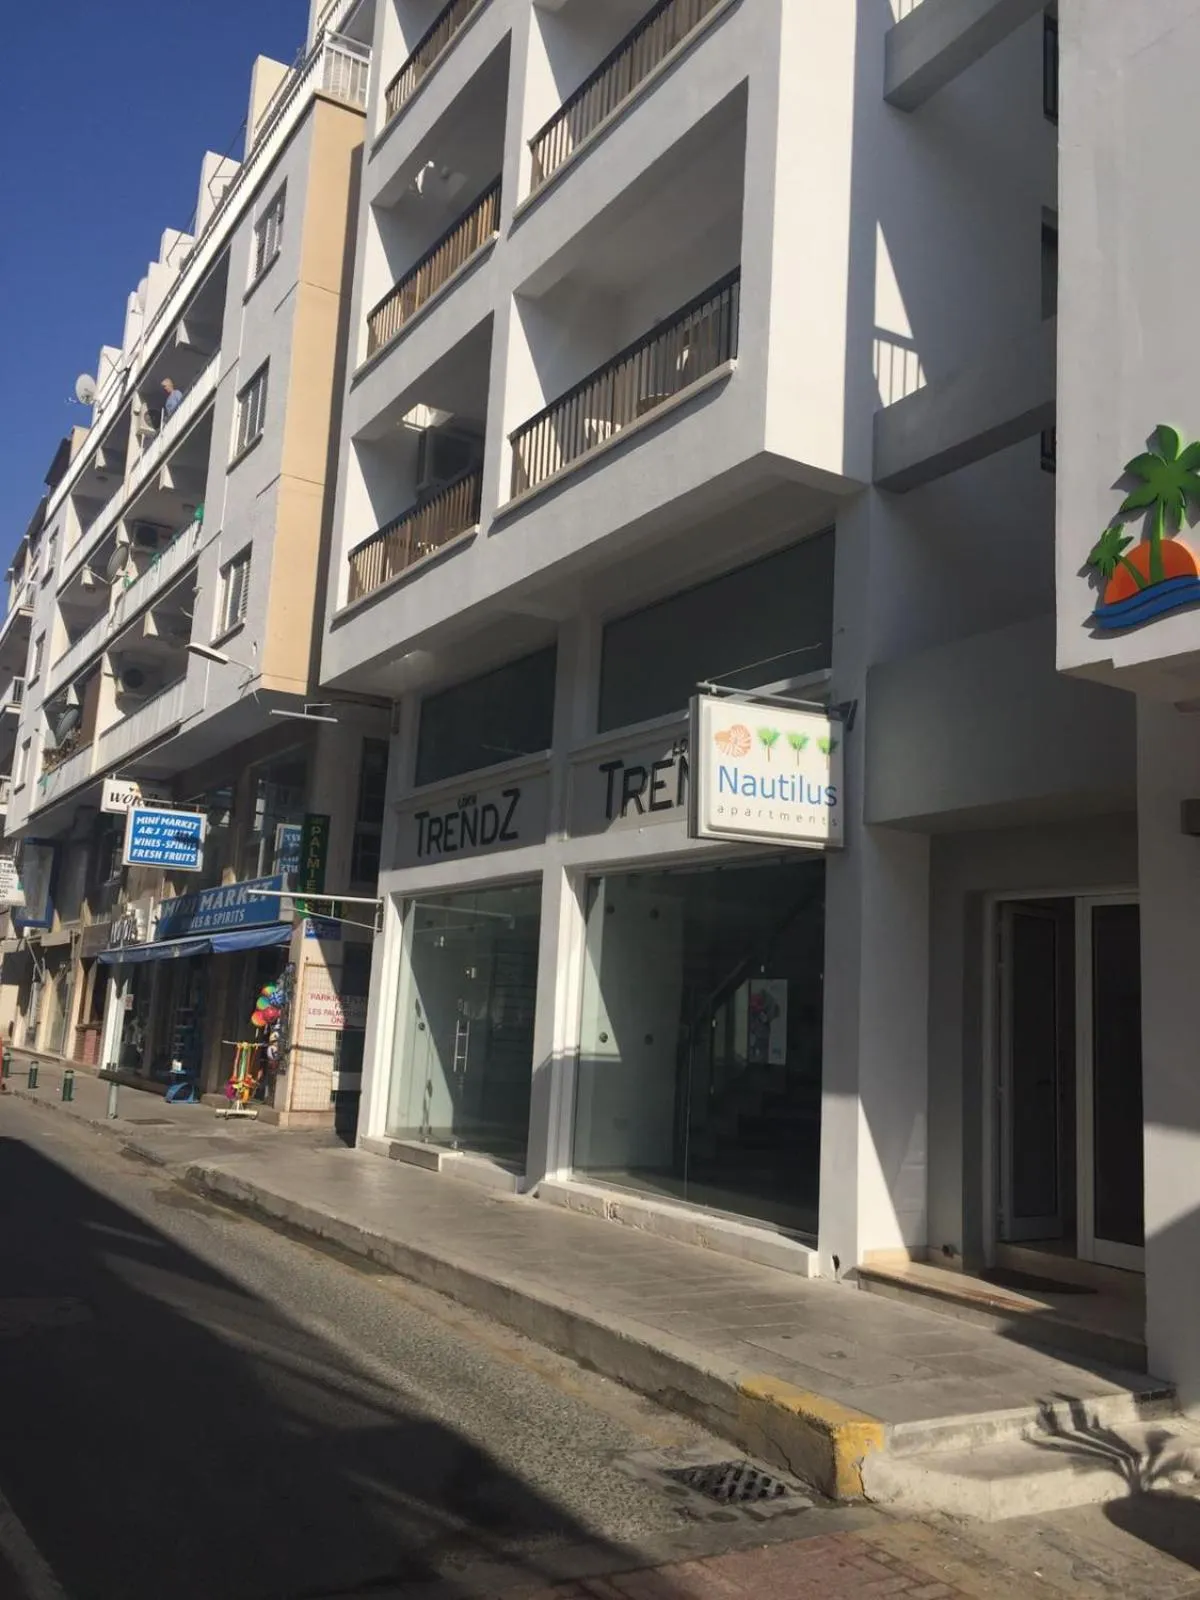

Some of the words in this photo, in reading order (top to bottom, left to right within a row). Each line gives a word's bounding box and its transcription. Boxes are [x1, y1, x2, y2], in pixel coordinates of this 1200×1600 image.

[718, 765, 837, 807] Nautilus
[160, 818, 199, 830] MARKET
[415, 788, 520, 857] TRENDZ
[717, 804, 838, 827] apartments
[134, 837, 161, 848] WINES
[131, 848, 162, 859] FRESH
[163, 850, 197, 862] FRUITS
[200, 881, 273, 912] MARKET
[212, 908, 246, 926] SPIRITS
